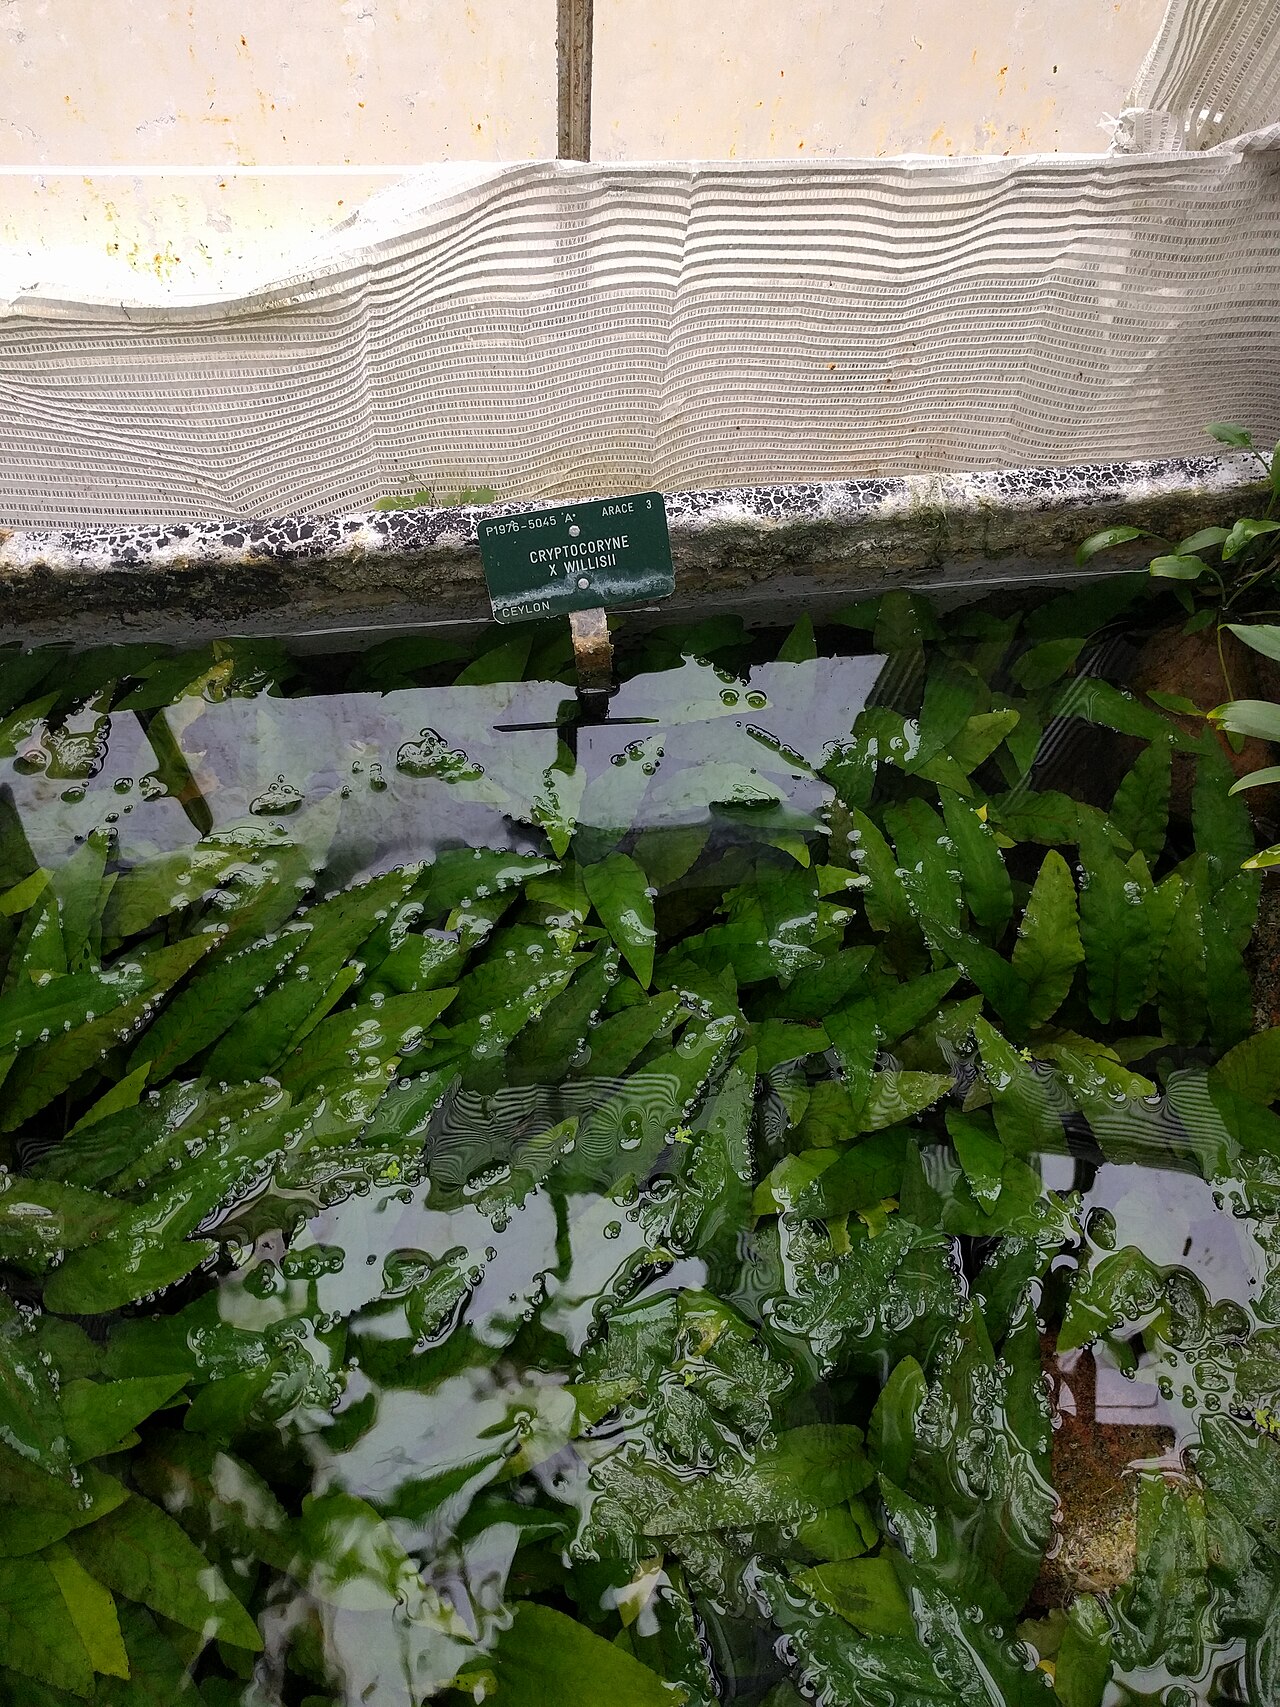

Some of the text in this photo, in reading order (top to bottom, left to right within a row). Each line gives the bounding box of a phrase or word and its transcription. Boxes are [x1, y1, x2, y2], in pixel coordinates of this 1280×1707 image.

[601, 499, 652, 518] ARACE 3
[485, 515, 557, 537] P1976-5045
[529, 535, 630, 564] CRYPTOCORYNE
[548, 554, 616, 577] X WILLISII
[502, 601, 550, 618] CEYLON
